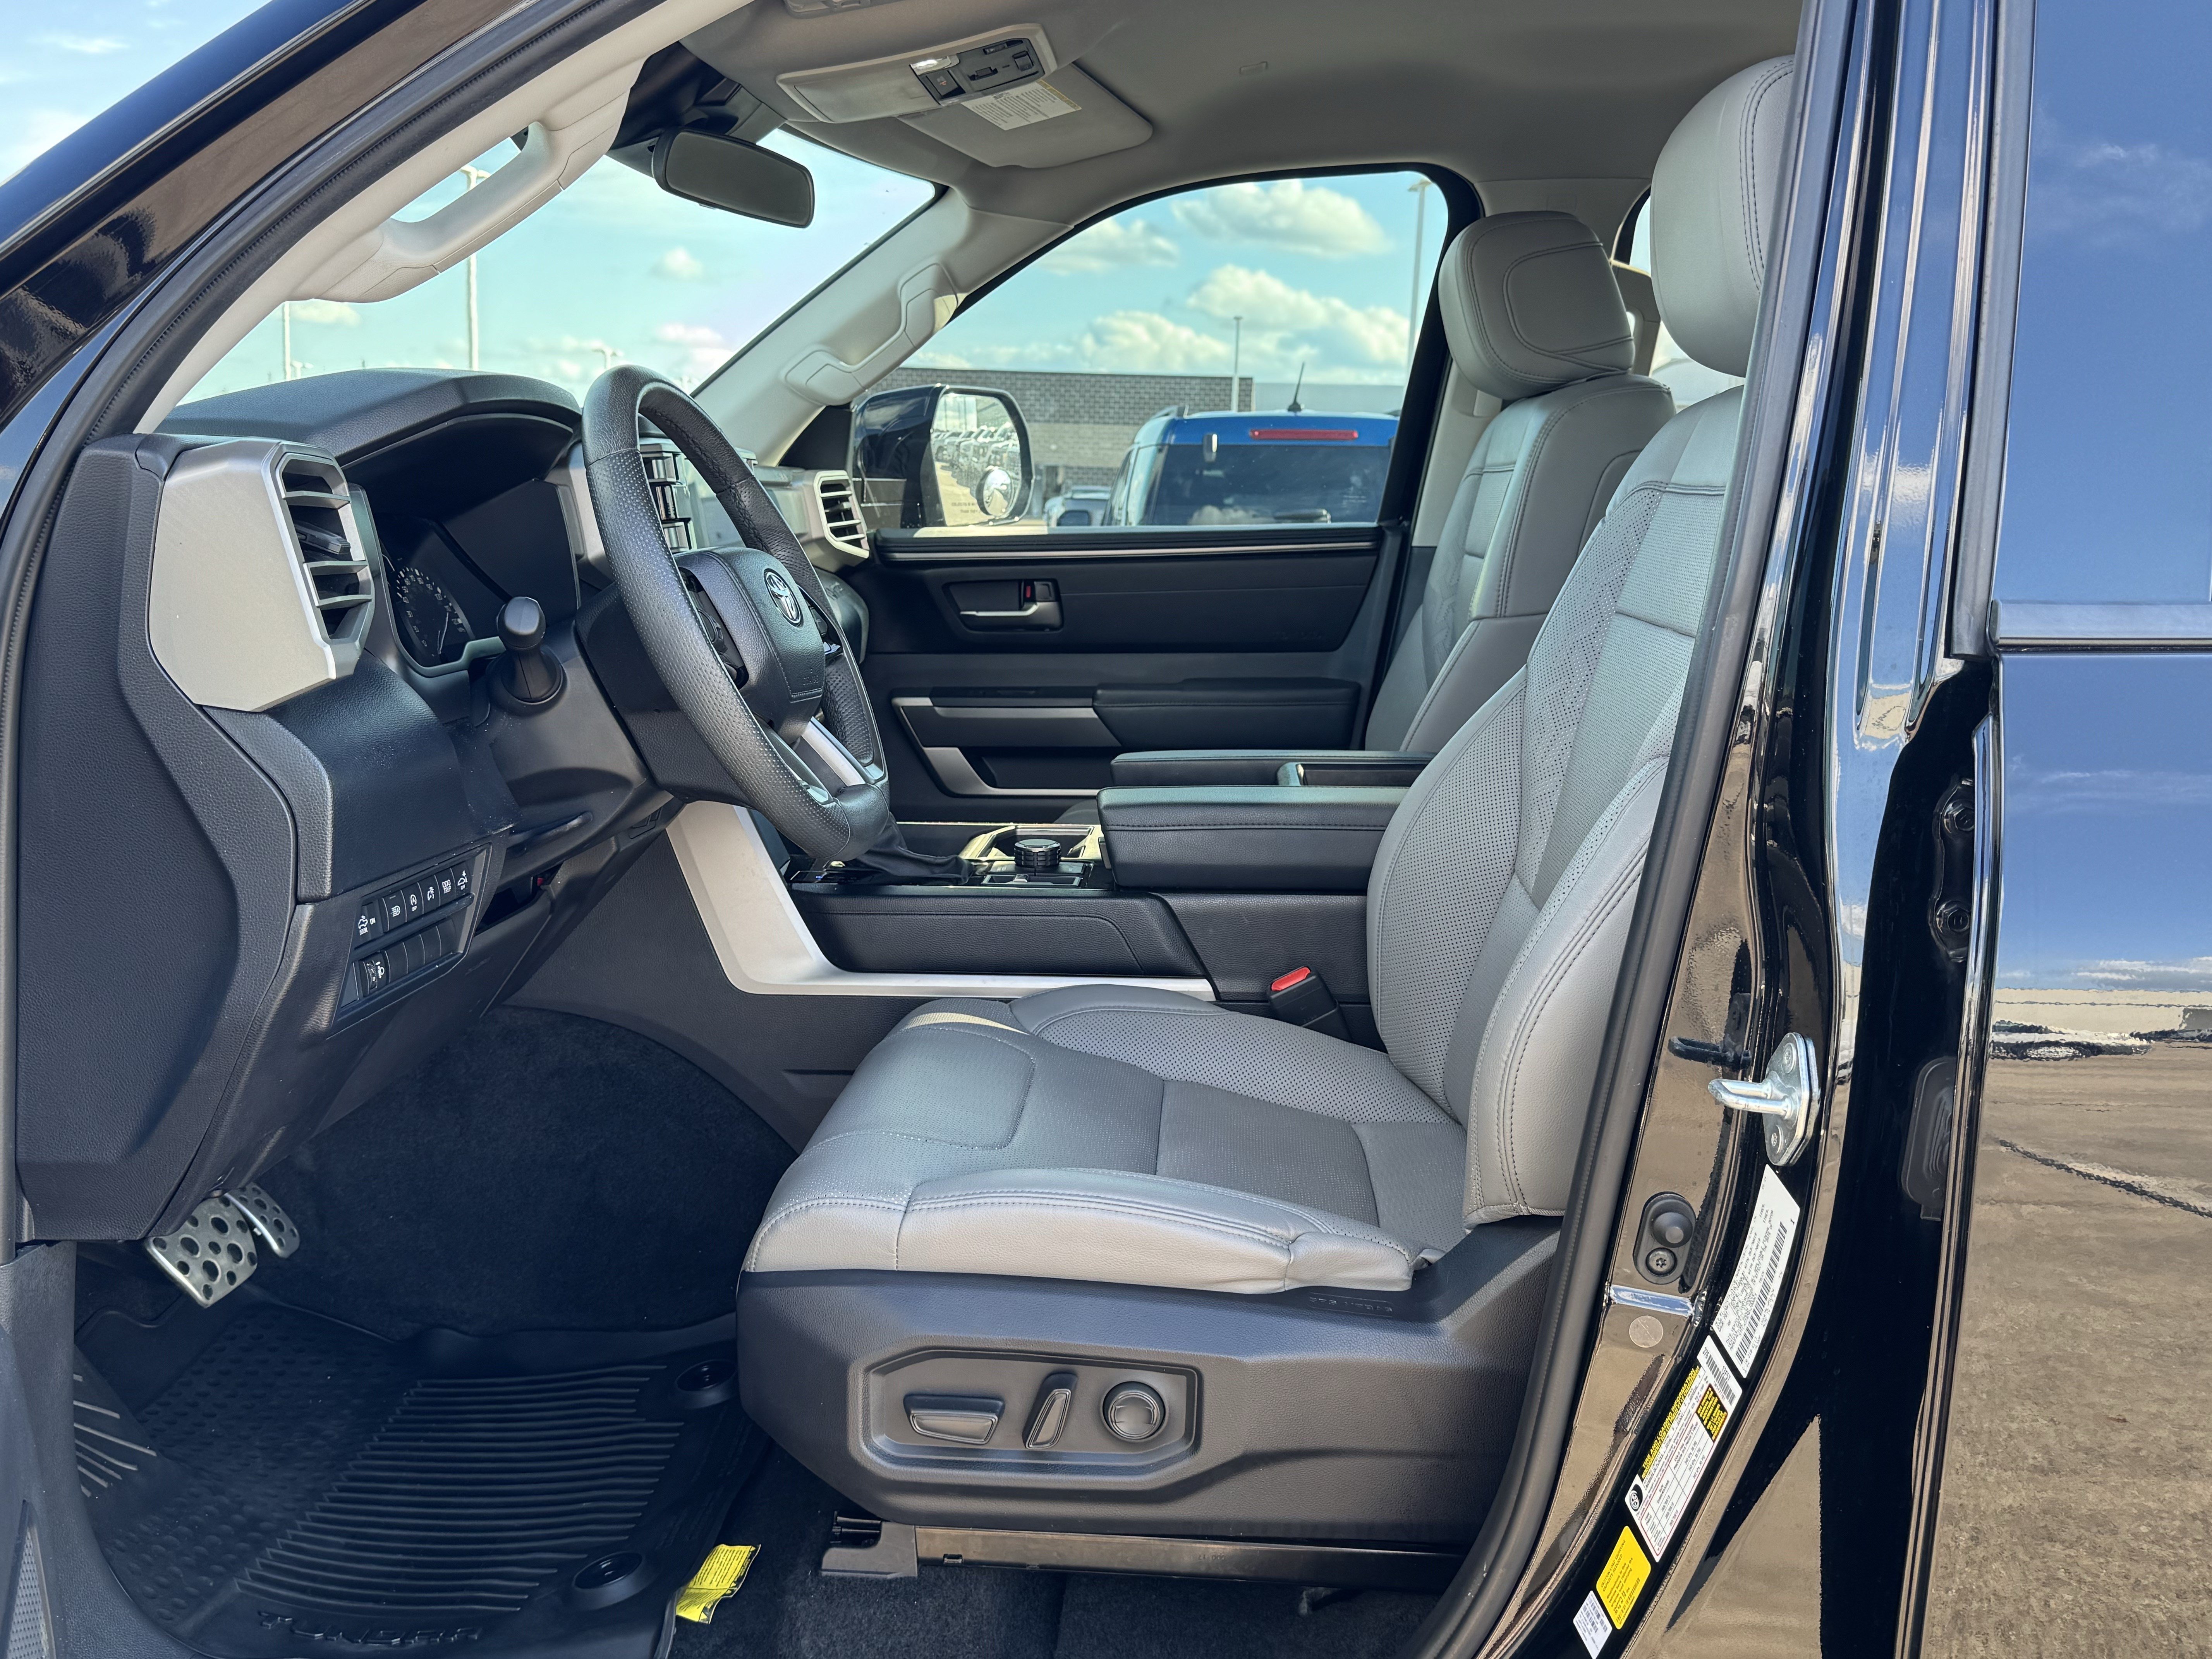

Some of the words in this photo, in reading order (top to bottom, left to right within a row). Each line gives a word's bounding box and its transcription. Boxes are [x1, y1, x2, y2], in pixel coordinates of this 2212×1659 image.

[1642, 1453, 1650, 1468] TIRE
[1657, 1412, 1672, 1440] LOADING
[1671, 1369, 1694, 1412] INFORMATION
[1601, 1571, 1610, 1587] CAUTION
[1603, 1573, 1613, 1592] CAPACITY
[1613, 1554, 1622, 1573] REDUCED
[258, 1610, 482, 1645] TUNDRA
